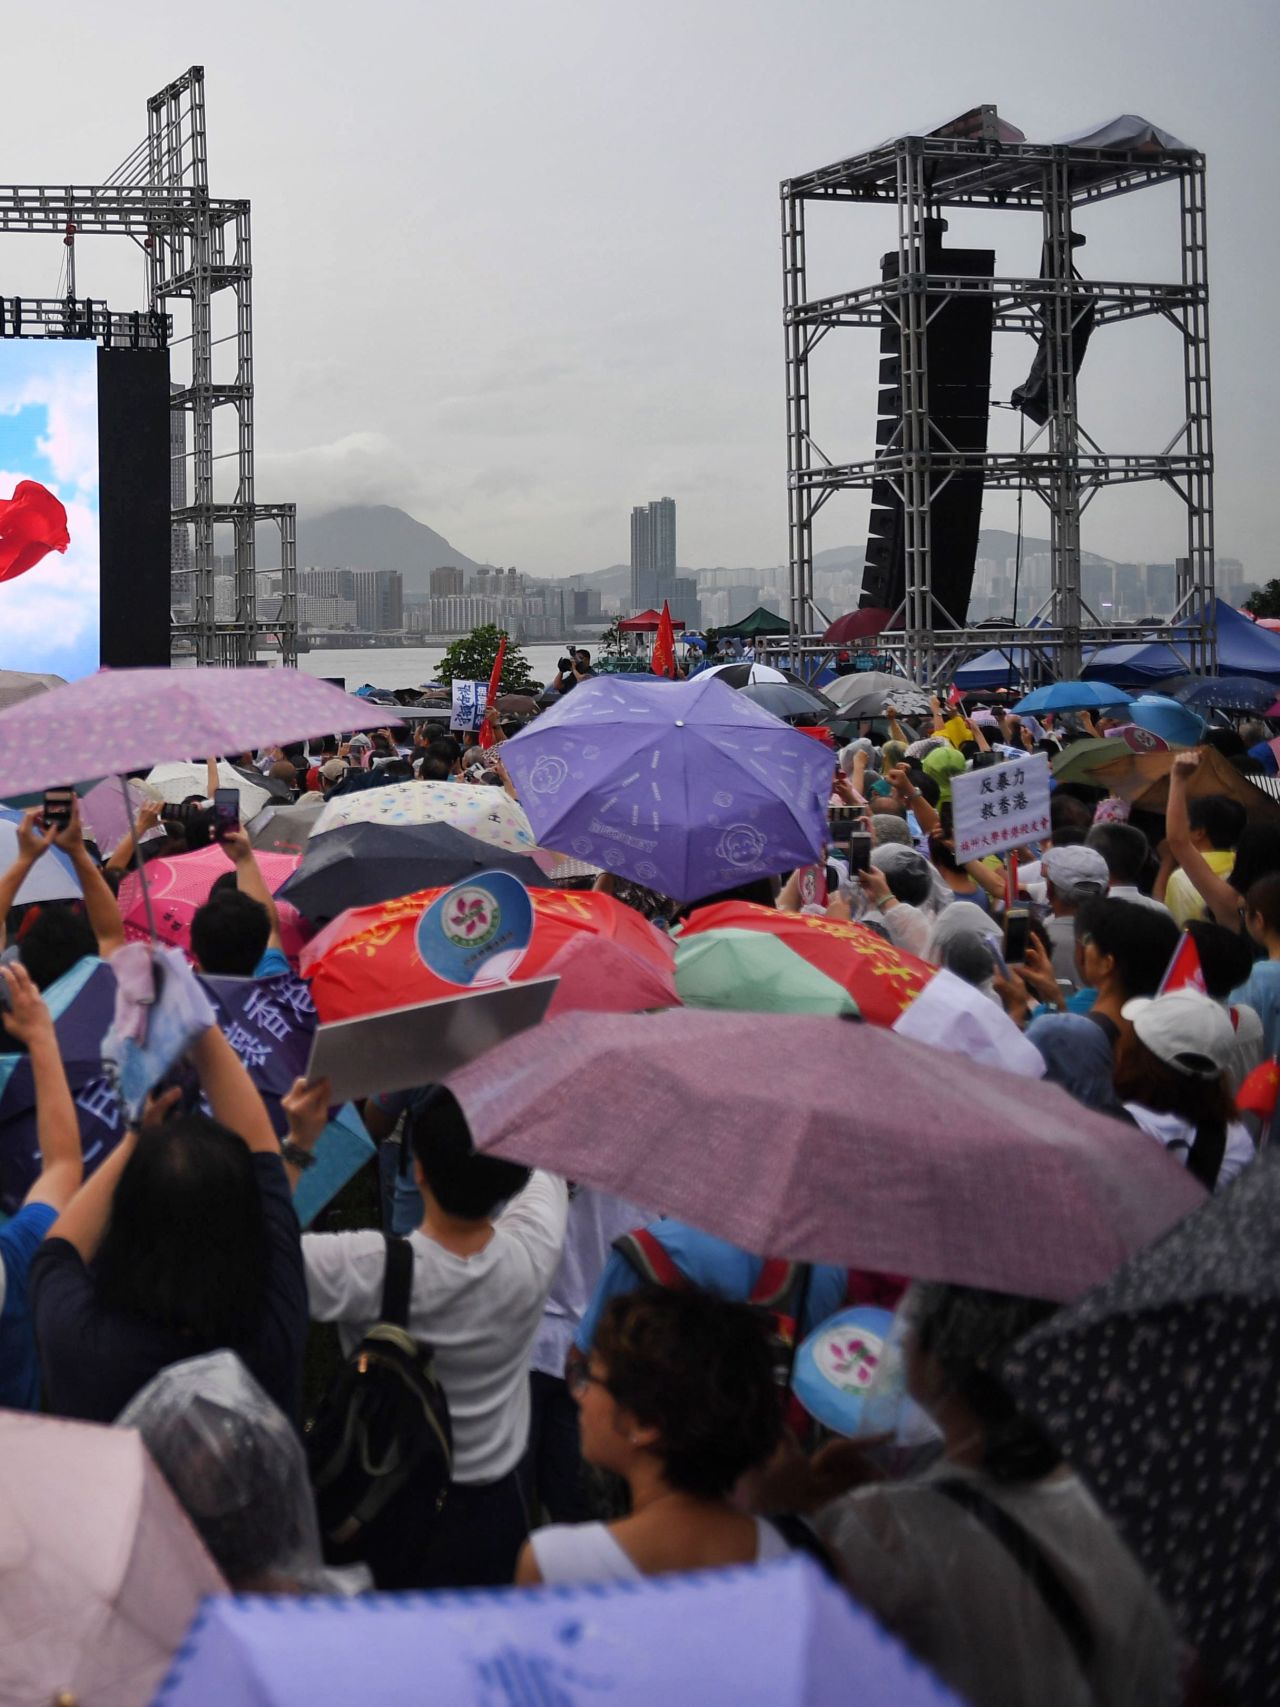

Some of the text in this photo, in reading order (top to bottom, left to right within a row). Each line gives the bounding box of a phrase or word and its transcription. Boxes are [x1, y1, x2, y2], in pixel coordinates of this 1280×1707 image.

[981, 768, 1025, 795] 反暴力
[980, 791, 1029, 820] 救香港
